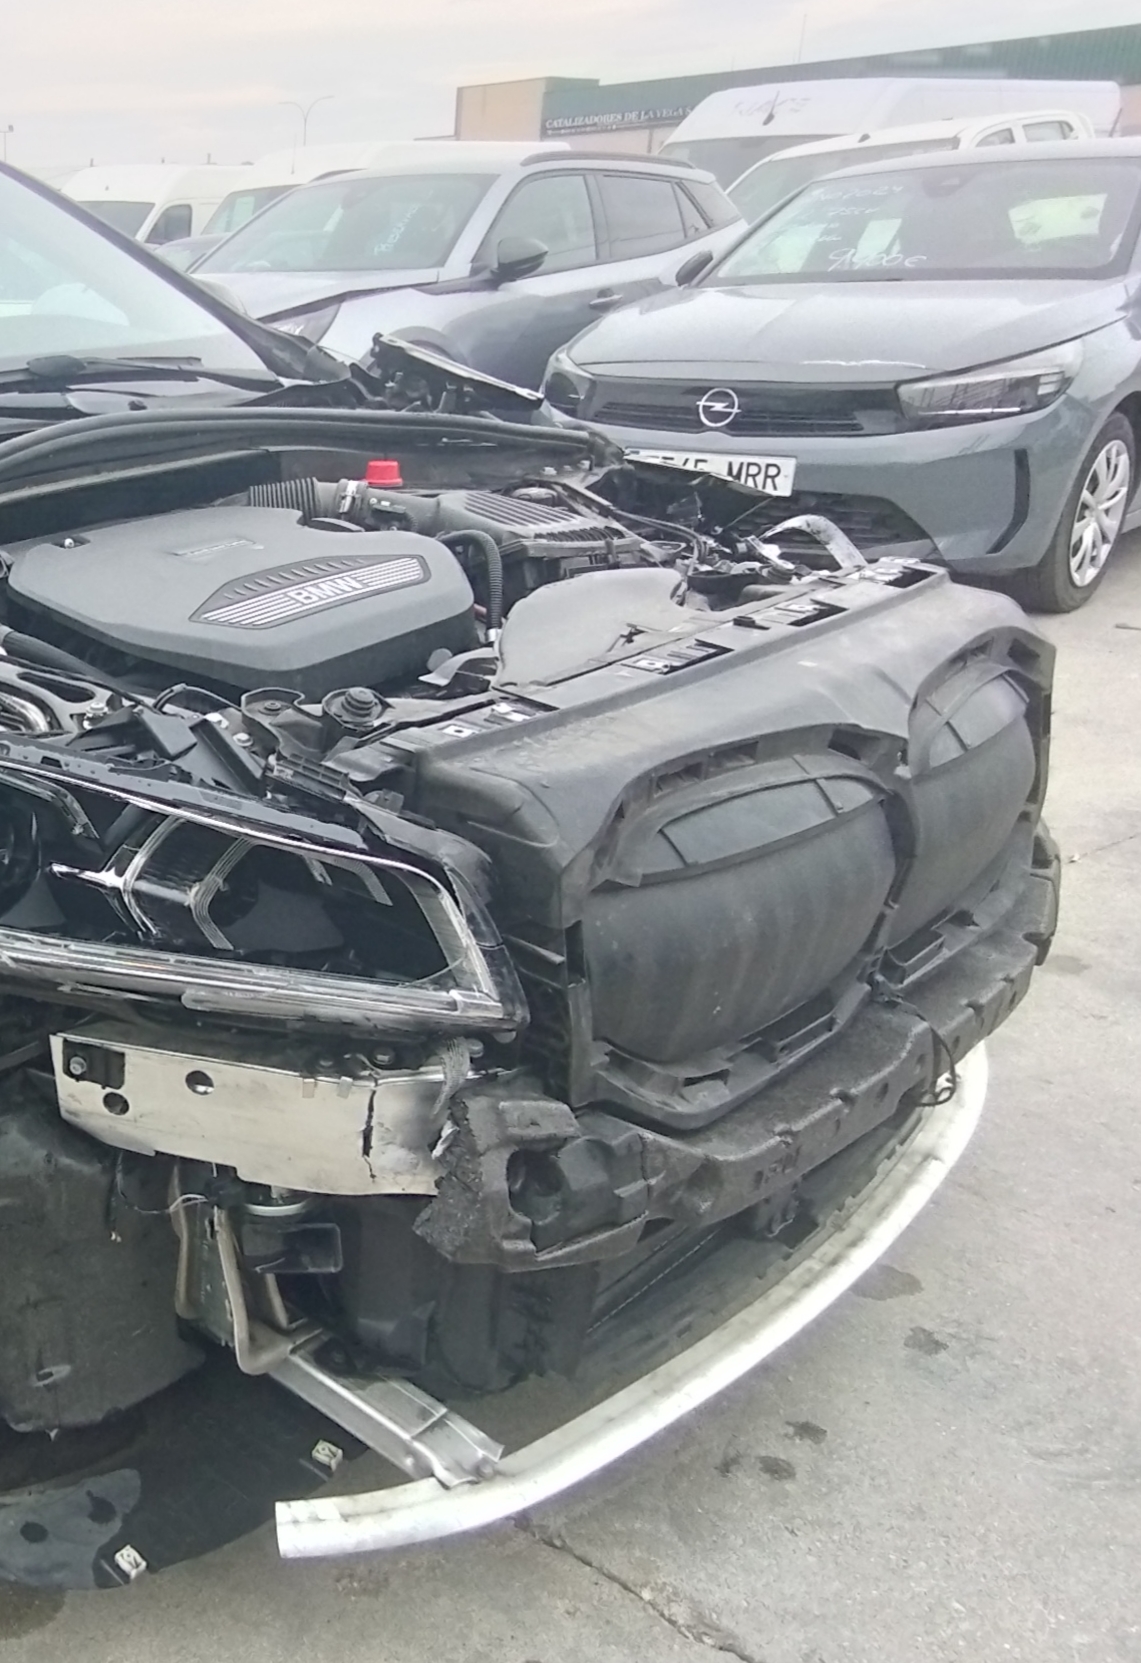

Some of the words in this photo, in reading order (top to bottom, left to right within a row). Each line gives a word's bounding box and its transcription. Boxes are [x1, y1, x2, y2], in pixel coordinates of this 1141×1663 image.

[546, 113, 622, 129] CATALIZADORES
[623, 111, 639, 121] DE
[640, 109, 654, 120] LA
[727, 461, 782, 491] MRR
[289, 577, 363, 605] BMW
